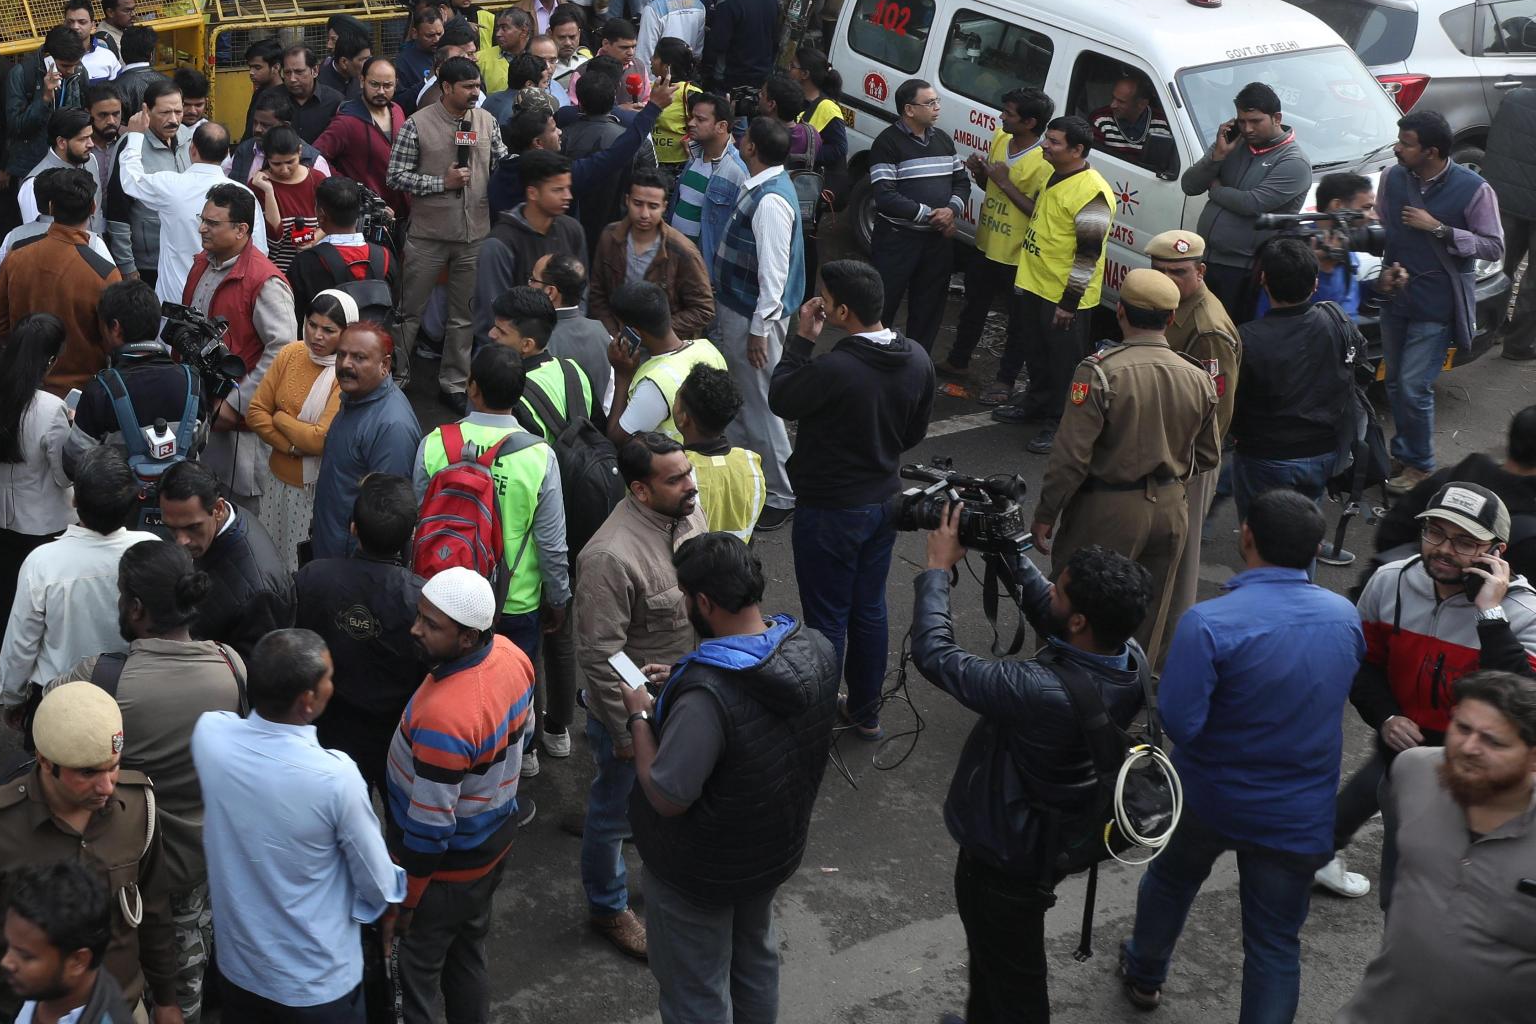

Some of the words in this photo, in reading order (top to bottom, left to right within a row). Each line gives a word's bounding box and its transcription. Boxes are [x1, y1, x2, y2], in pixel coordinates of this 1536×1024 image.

[1225, 46, 1256, 60] GOVT.
[1256, 44, 1271, 55] OF
[1271, 39, 1300, 52] DELHI
[969, 109, 996, 132] CATS
